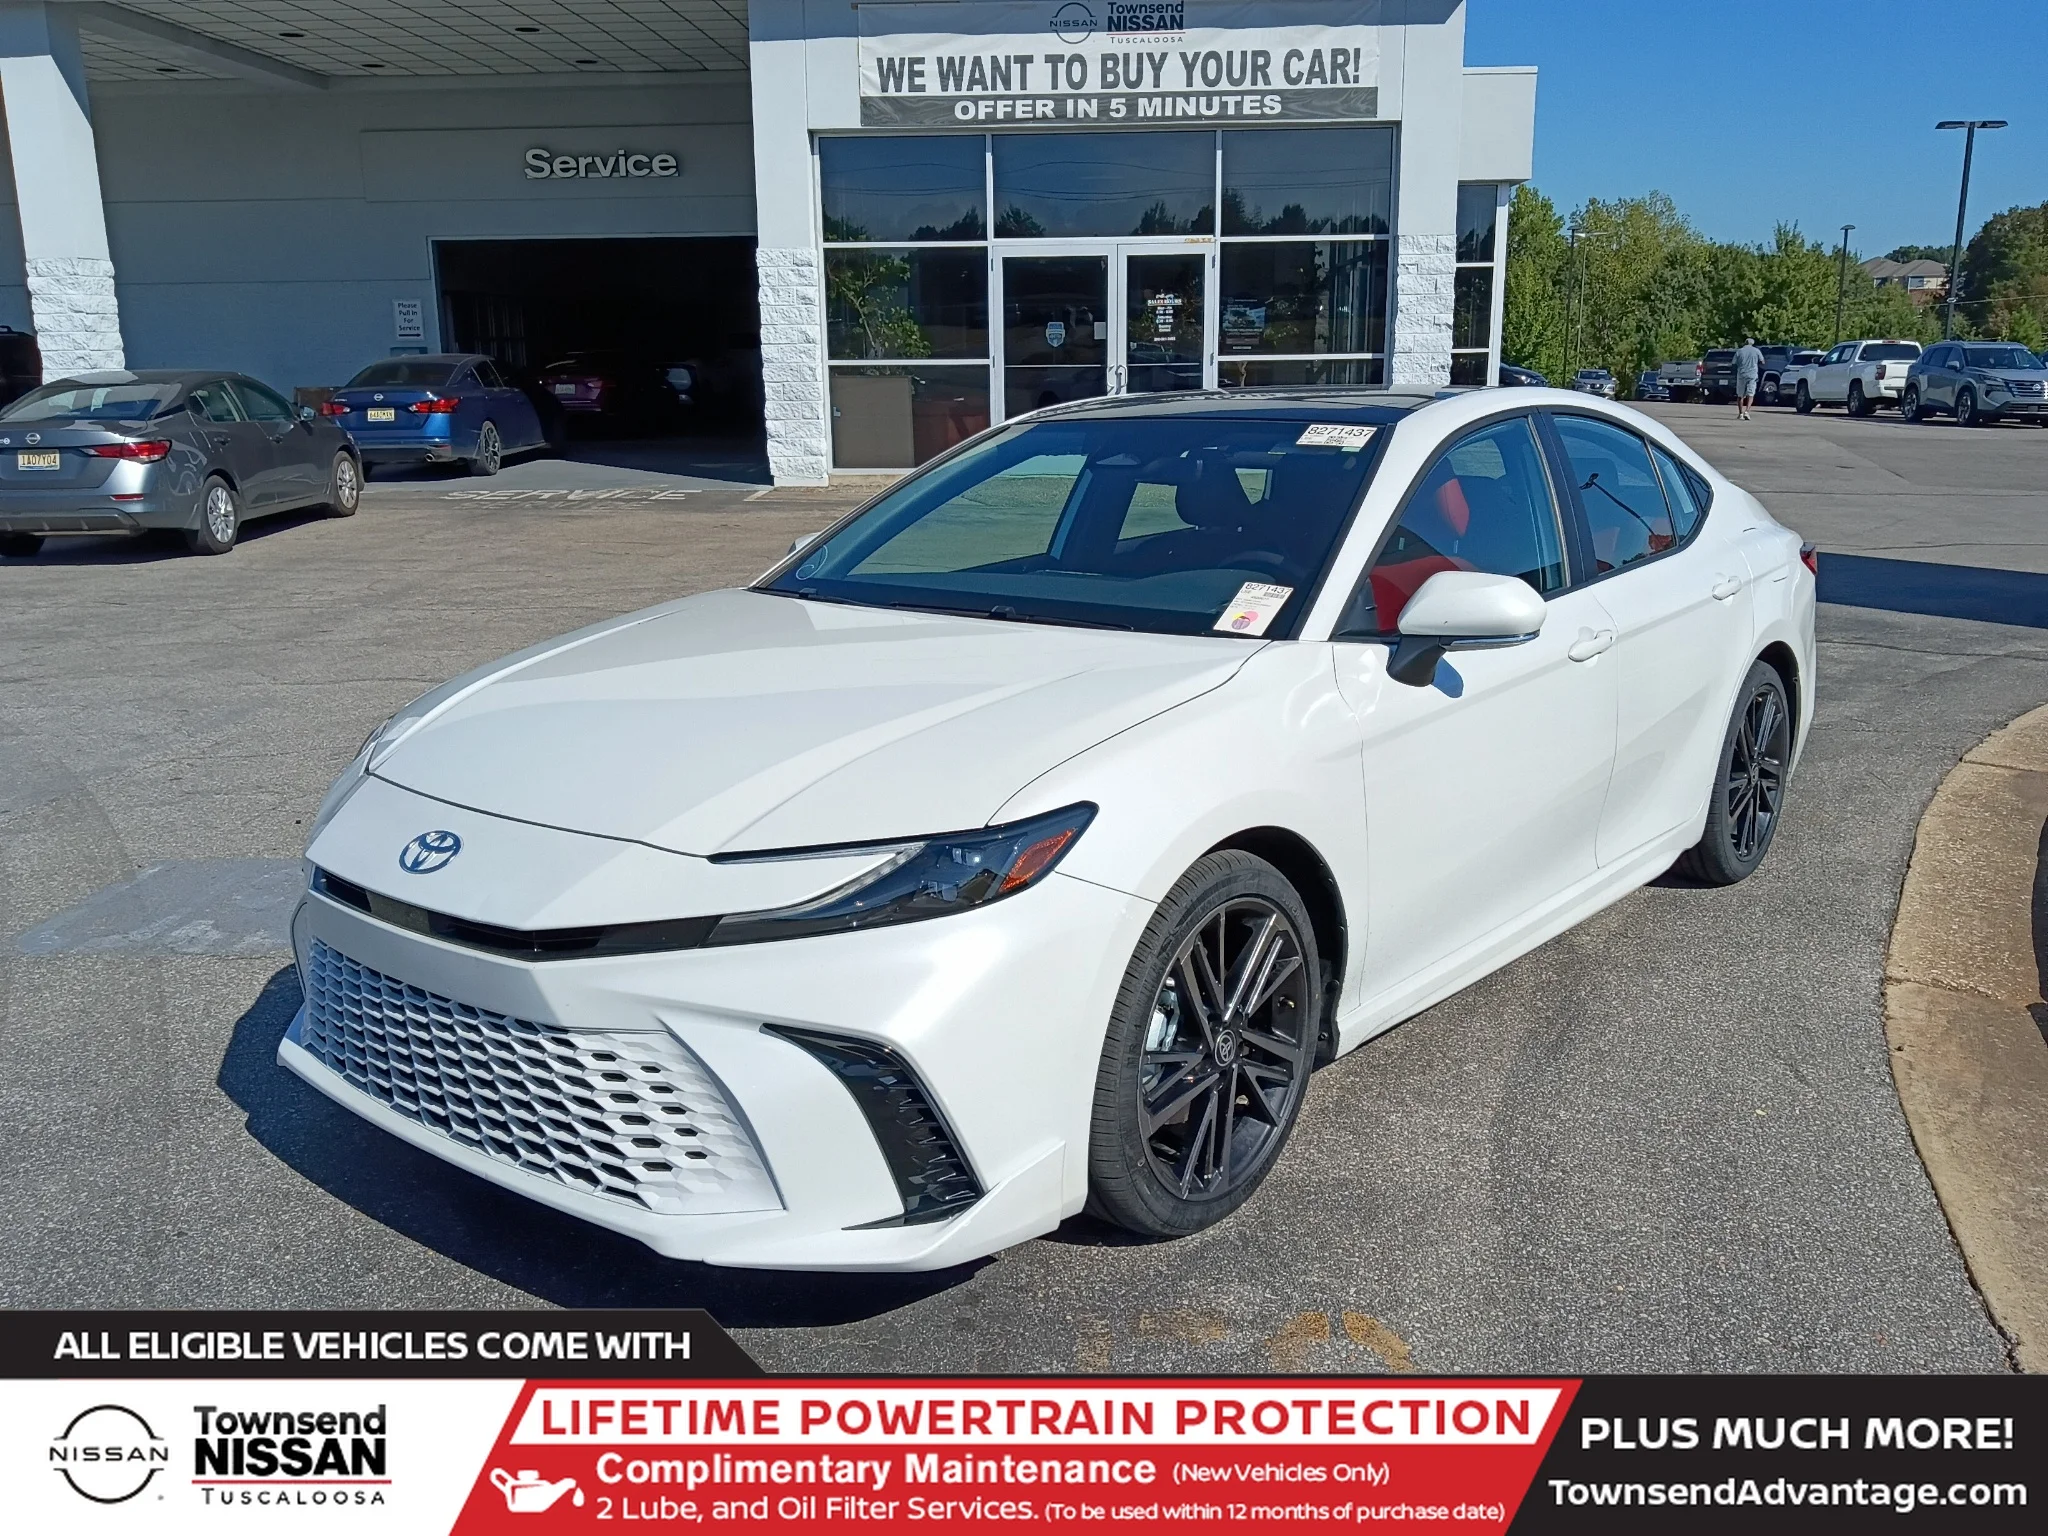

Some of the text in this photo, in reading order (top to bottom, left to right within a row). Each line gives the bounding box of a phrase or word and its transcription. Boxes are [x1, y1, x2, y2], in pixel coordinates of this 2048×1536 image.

[1107, 0, 1184, 15] Townsend
[1049, 20, 1098, 28] NISSAN
[1107, 15, 1184, 32] NISSAN
[1110, 36, 1184, 44] TUSCALOOSA
[876, 47, 1361, 93] WE WANT TO BUY YOUR CAR!
[954, 95, 1283, 120] OFFER IN 5 MINUTES
[524, 148, 677, 179] Service
[1308, 426, 1375, 437] 8271437
[1245, 583, 1293, 595] 8271437
